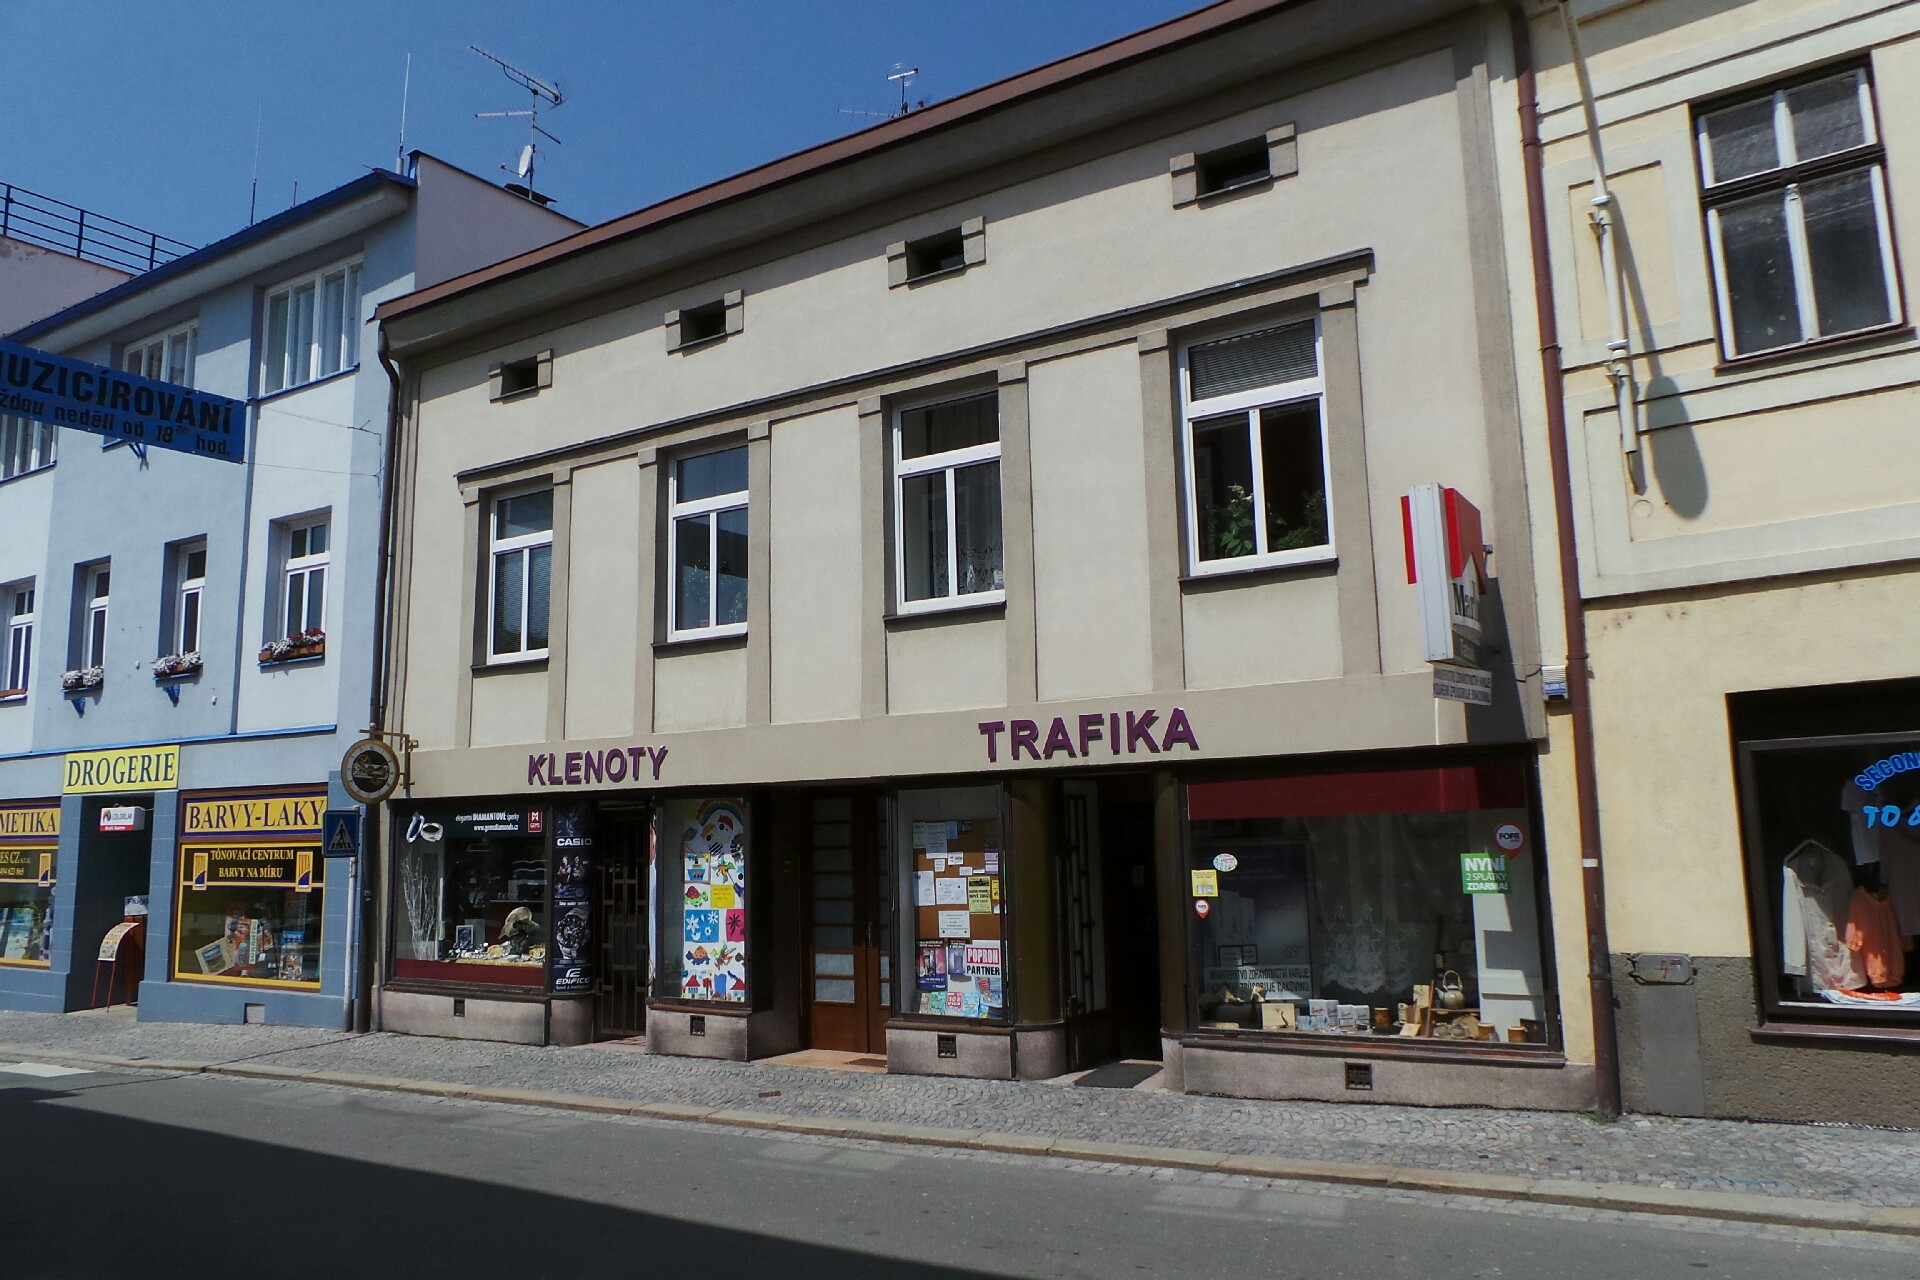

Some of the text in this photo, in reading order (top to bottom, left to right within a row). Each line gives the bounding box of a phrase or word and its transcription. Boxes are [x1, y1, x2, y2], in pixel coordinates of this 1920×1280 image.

[54, 404, 114, 431] neděli
[123, 421, 144, 437] od
[196, 433, 231, 456] hod.
[978, 707, 1200, 763] TRAFIKA
[66, 752, 175, 787] DROGERIE
[527, 745, 669, 786] KLENOTY
[188, 799, 325, 829] BARVY-LAKY
[556, 837, 592, 847] CASIO
[210, 847, 295, 861] TÓNOVACÍ CENTRUM
[1464, 855, 1506, 871] NYNÍ
[218, 864, 284, 879] BARVY NA MÍRU
[1466, 870, 1507, 881] 2 SPLÁTKY
[1467, 882, 1508, 891] ZDARMA!
[967, 947, 999, 964] POPRON
[966, 965, 1000, 976] PARTNER
[556, 976, 591, 985] EDIFICE
